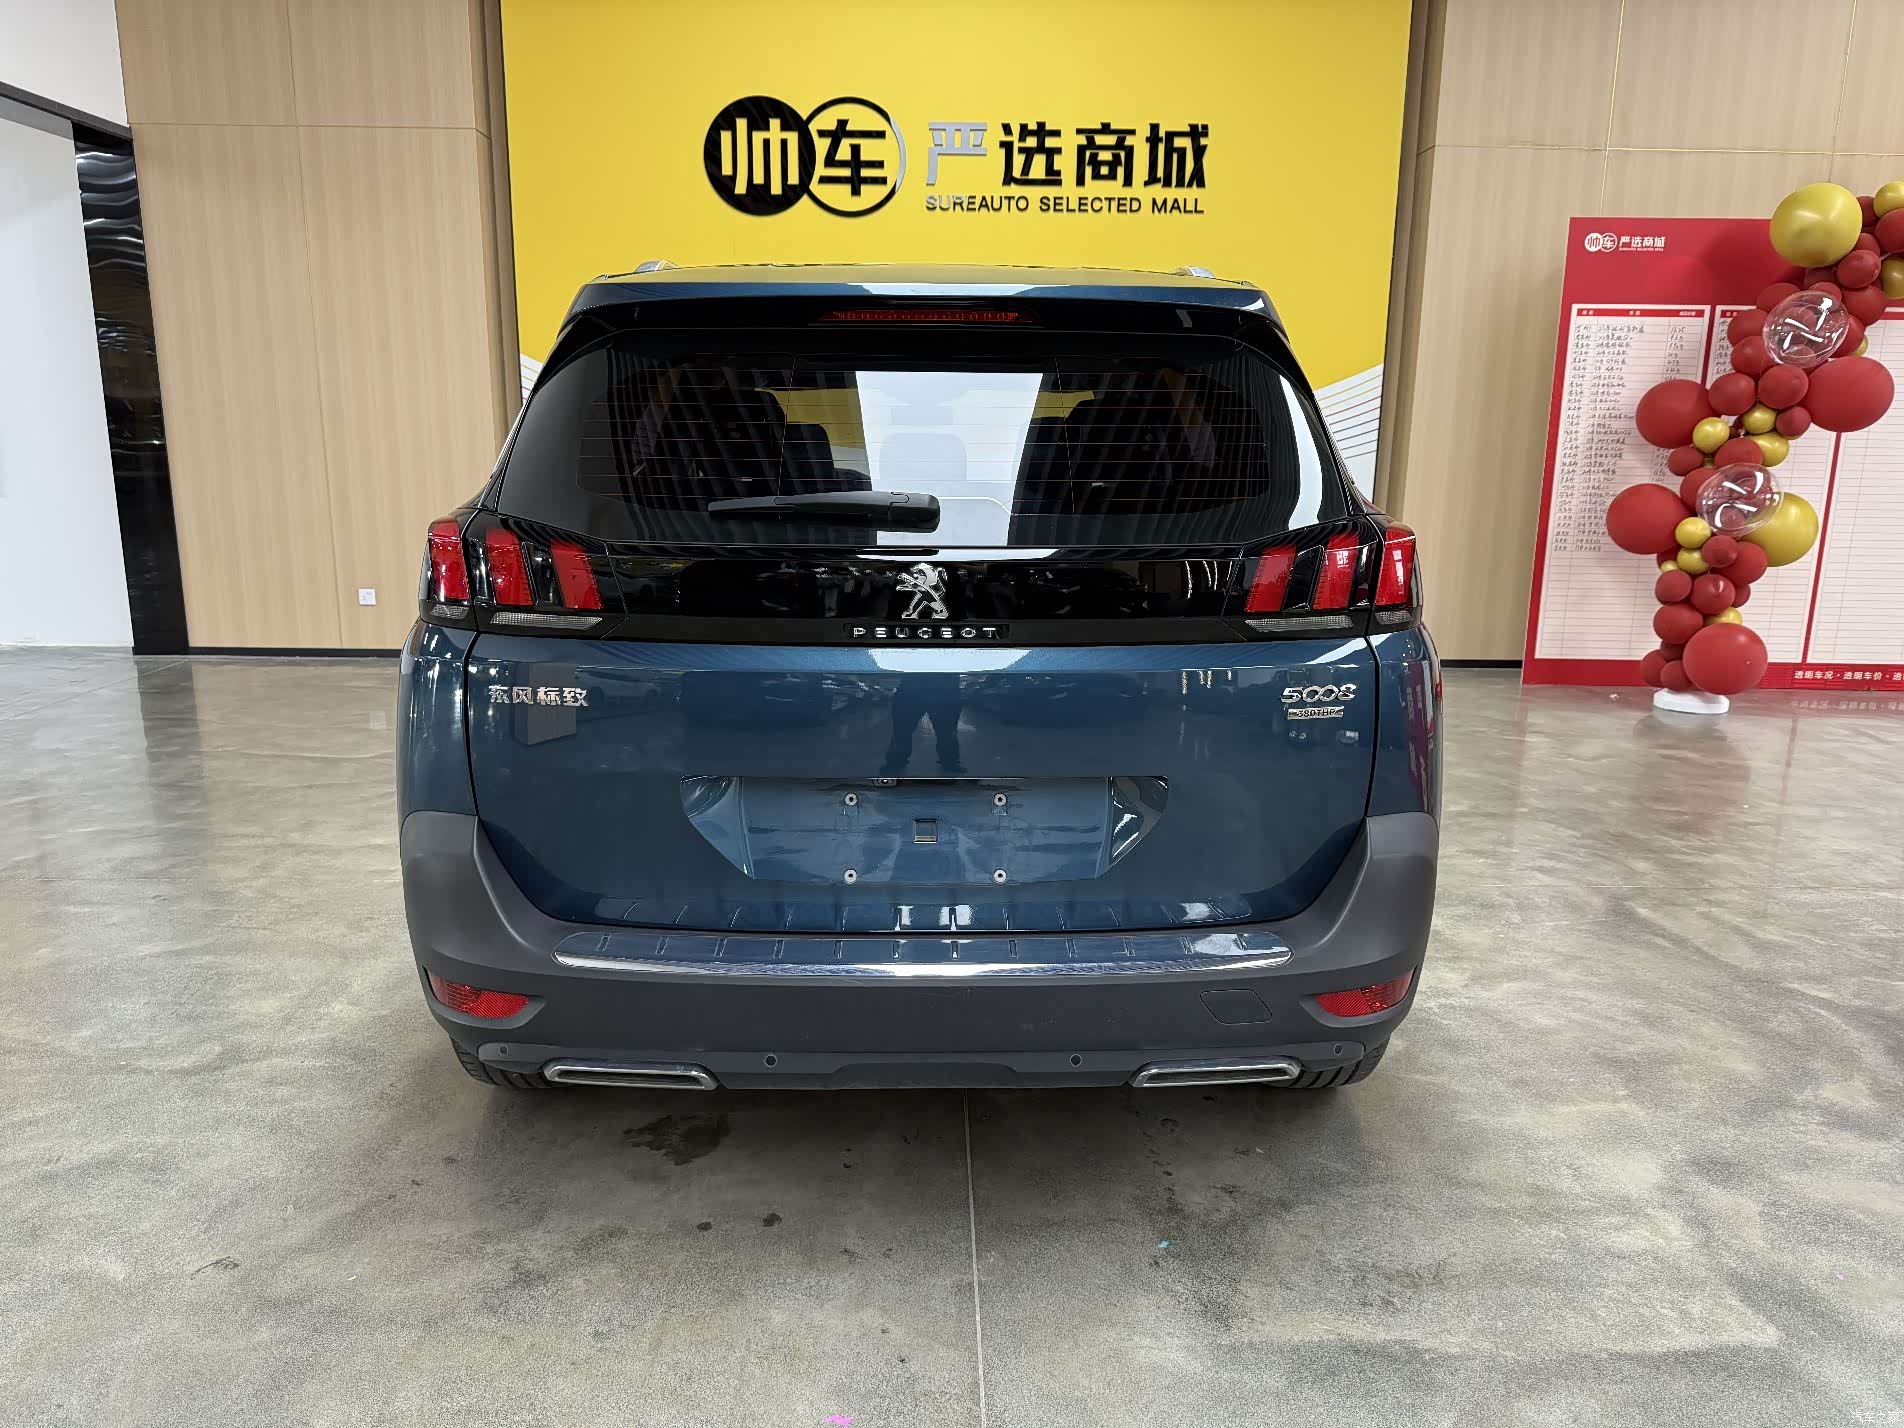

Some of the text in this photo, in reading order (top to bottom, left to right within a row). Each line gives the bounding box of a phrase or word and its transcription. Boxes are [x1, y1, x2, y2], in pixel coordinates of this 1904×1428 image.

[716, 114, 1209, 200] 帅车 严选商城
[925, 194, 1204, 214] SUREAUTO SELECTED MALL
[1619, 236, 1666, 247] 严选商城
[853, 627, 997, 639] PEUGEOT
[488, 684, 589, 707] 东风标致
[1280, 683, 1358, 703] 5008
[1297, 708, 1337, 718] 380THP
